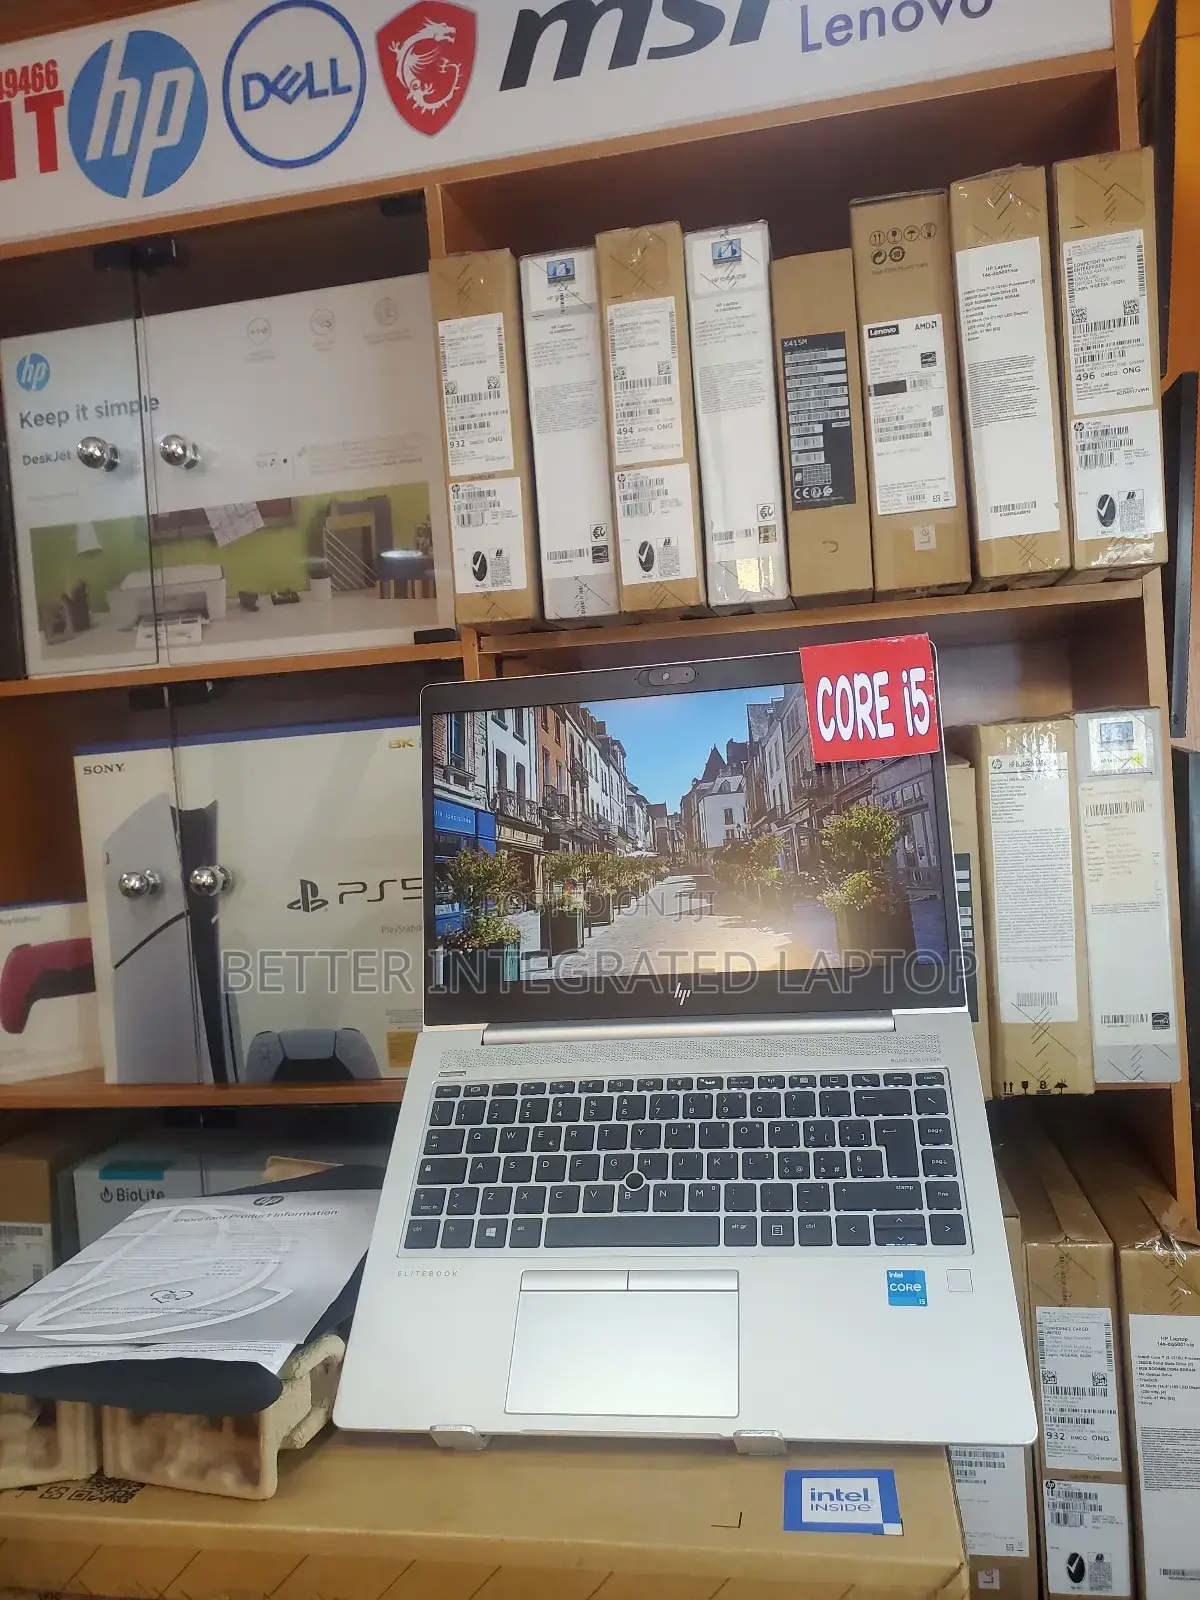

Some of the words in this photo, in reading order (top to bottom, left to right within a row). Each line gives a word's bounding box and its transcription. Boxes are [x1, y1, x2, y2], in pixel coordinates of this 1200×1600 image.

[801, 0, 990, 54] Lenovo
[0, 59, 58, 98] 9466
[242, 57, 352, 112] DELL
[86, 33, 195, 198] hp
[915, 321, 930, 331] AMD
[784, 339, 807, 347] X415M
[21, 353, 46, 391] hp
[1076, 372, 1095, 381] 496
[1123, 366, 1141, 374] ONG
[19, 410, 69, 428] Keep
[76, 404, 88, 421] it
[95, 395, 159, 419] simple
[617, 427, 633, 435] 494
[450, 440, 465, 448] 932
[23, 451, 72, 466] DeskJet
[816, 670, 895, 742] CORE
[902, 667, 930, 737] i5
[389, 740, 414, 748] 8K
[83, 763, 124, 775] SONY
[338, 877, 422, 904] PS5
[381, 925, 422, 934] PlayStatio
[116, 1188, 164, 1201] BioLite
[1047, 1432, 1065, 1440] 932
[810, 1488, 870, 1502] intel
